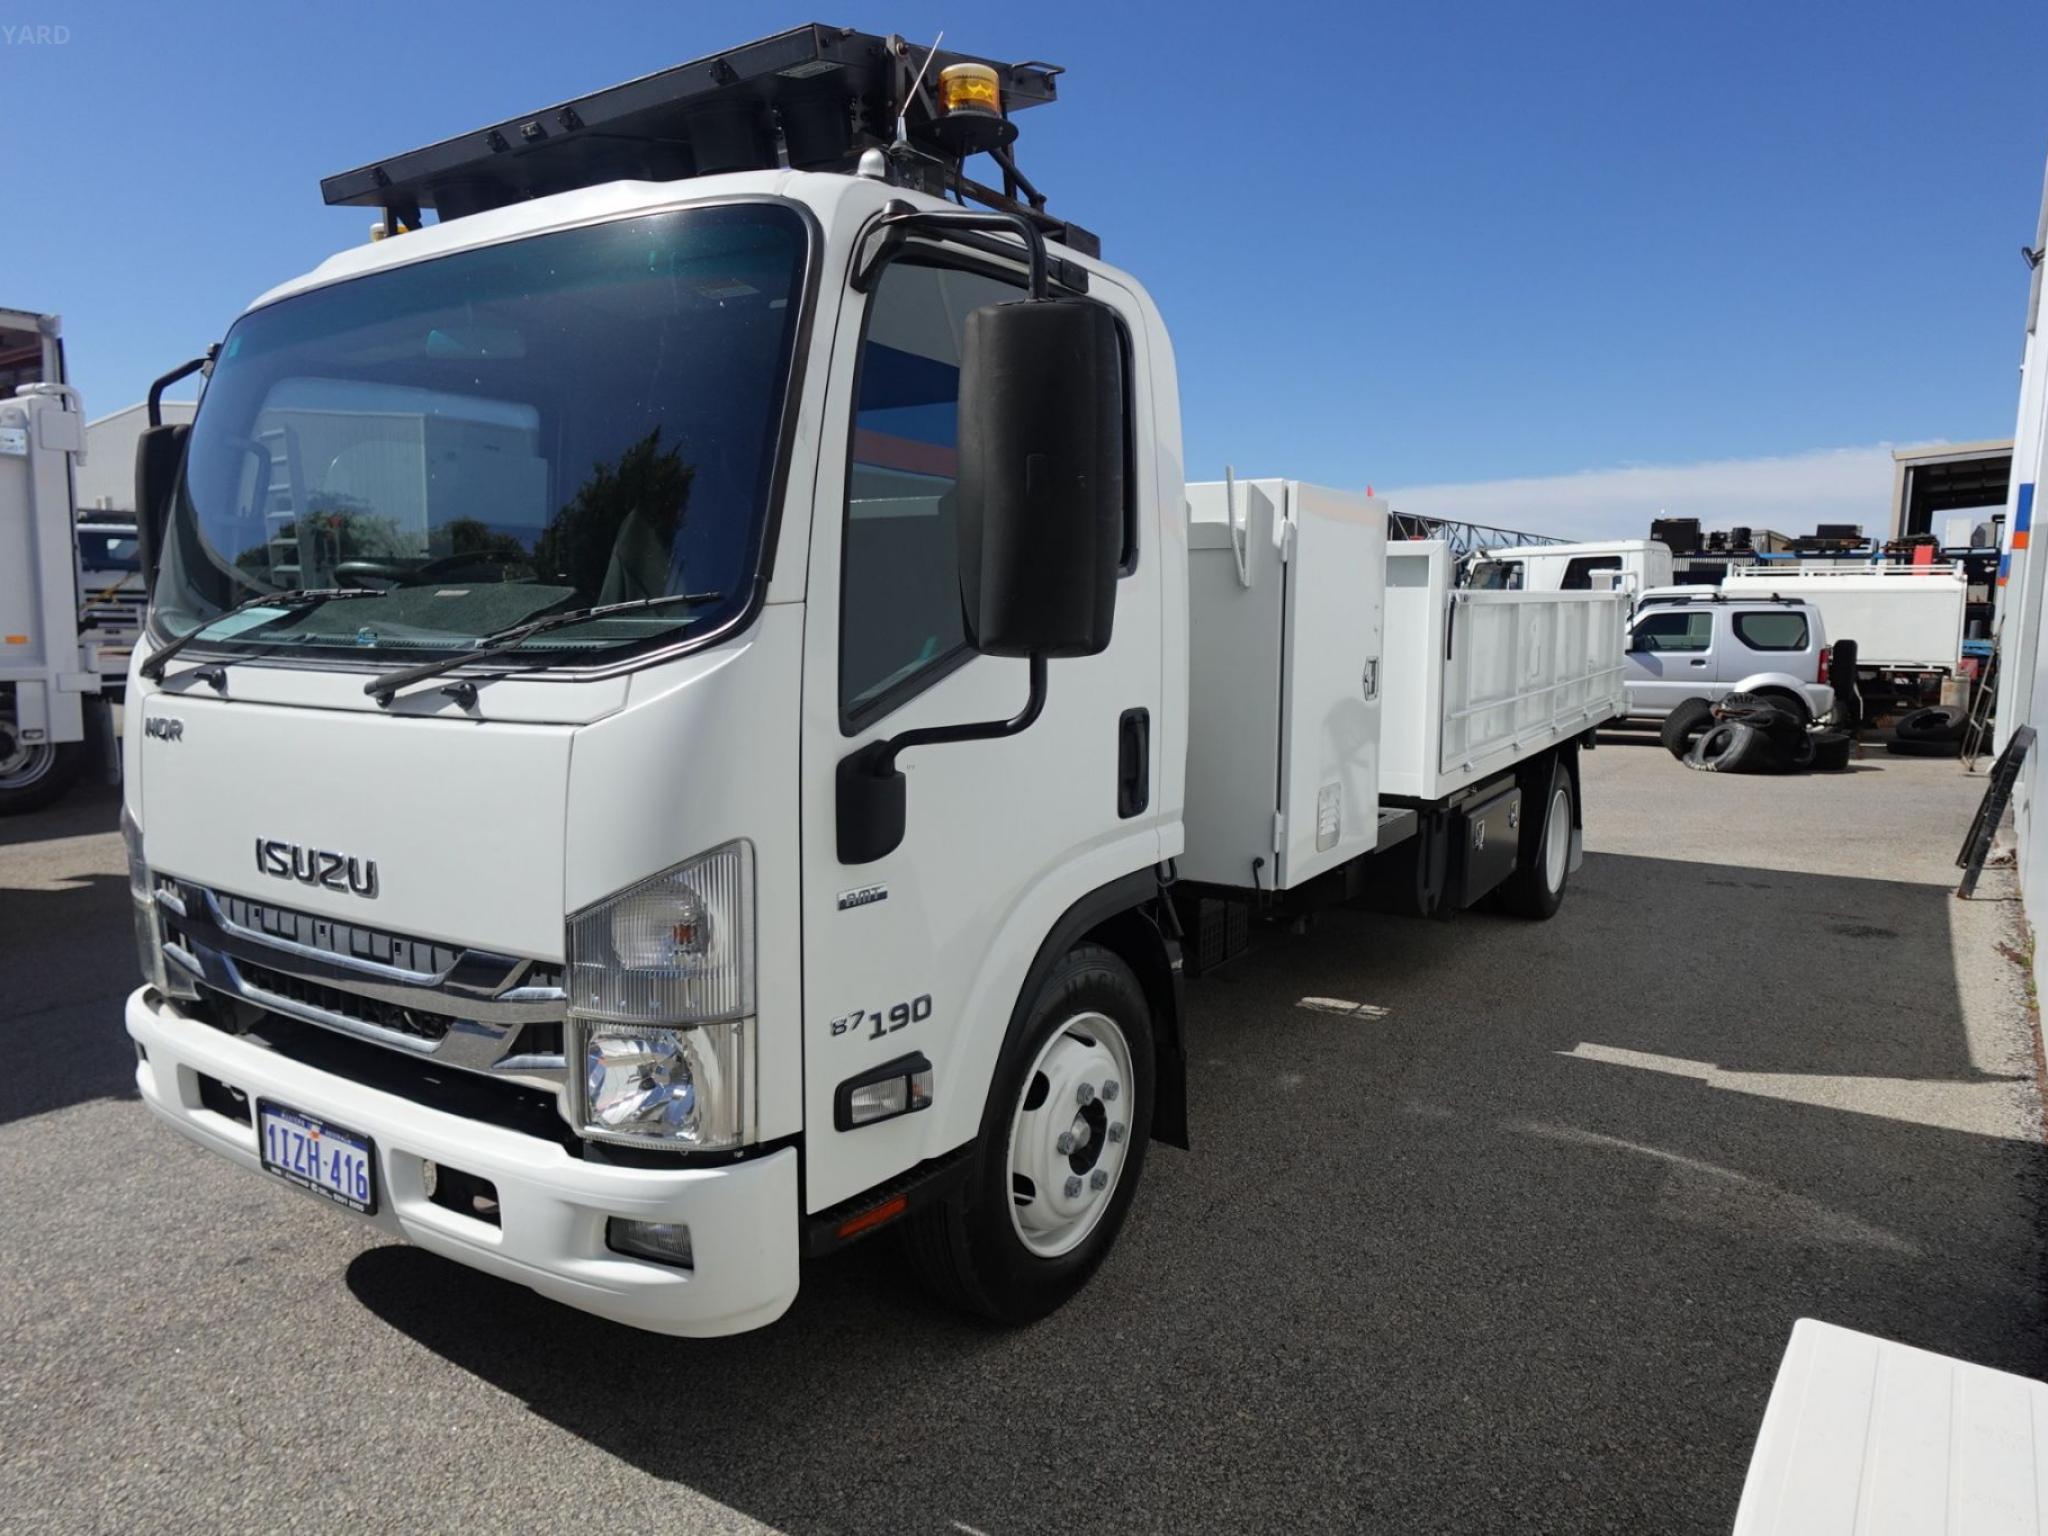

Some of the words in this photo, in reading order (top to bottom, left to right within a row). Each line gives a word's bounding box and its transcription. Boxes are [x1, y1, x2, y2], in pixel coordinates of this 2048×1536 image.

[145, 717, 184, 741] NQR
[255, 836, 379, 899] ISUZU
[845, 887, 882, 908] AMT
[830, 1010, 865, 1037] 87
[868, 993, 932, 1041] 190
